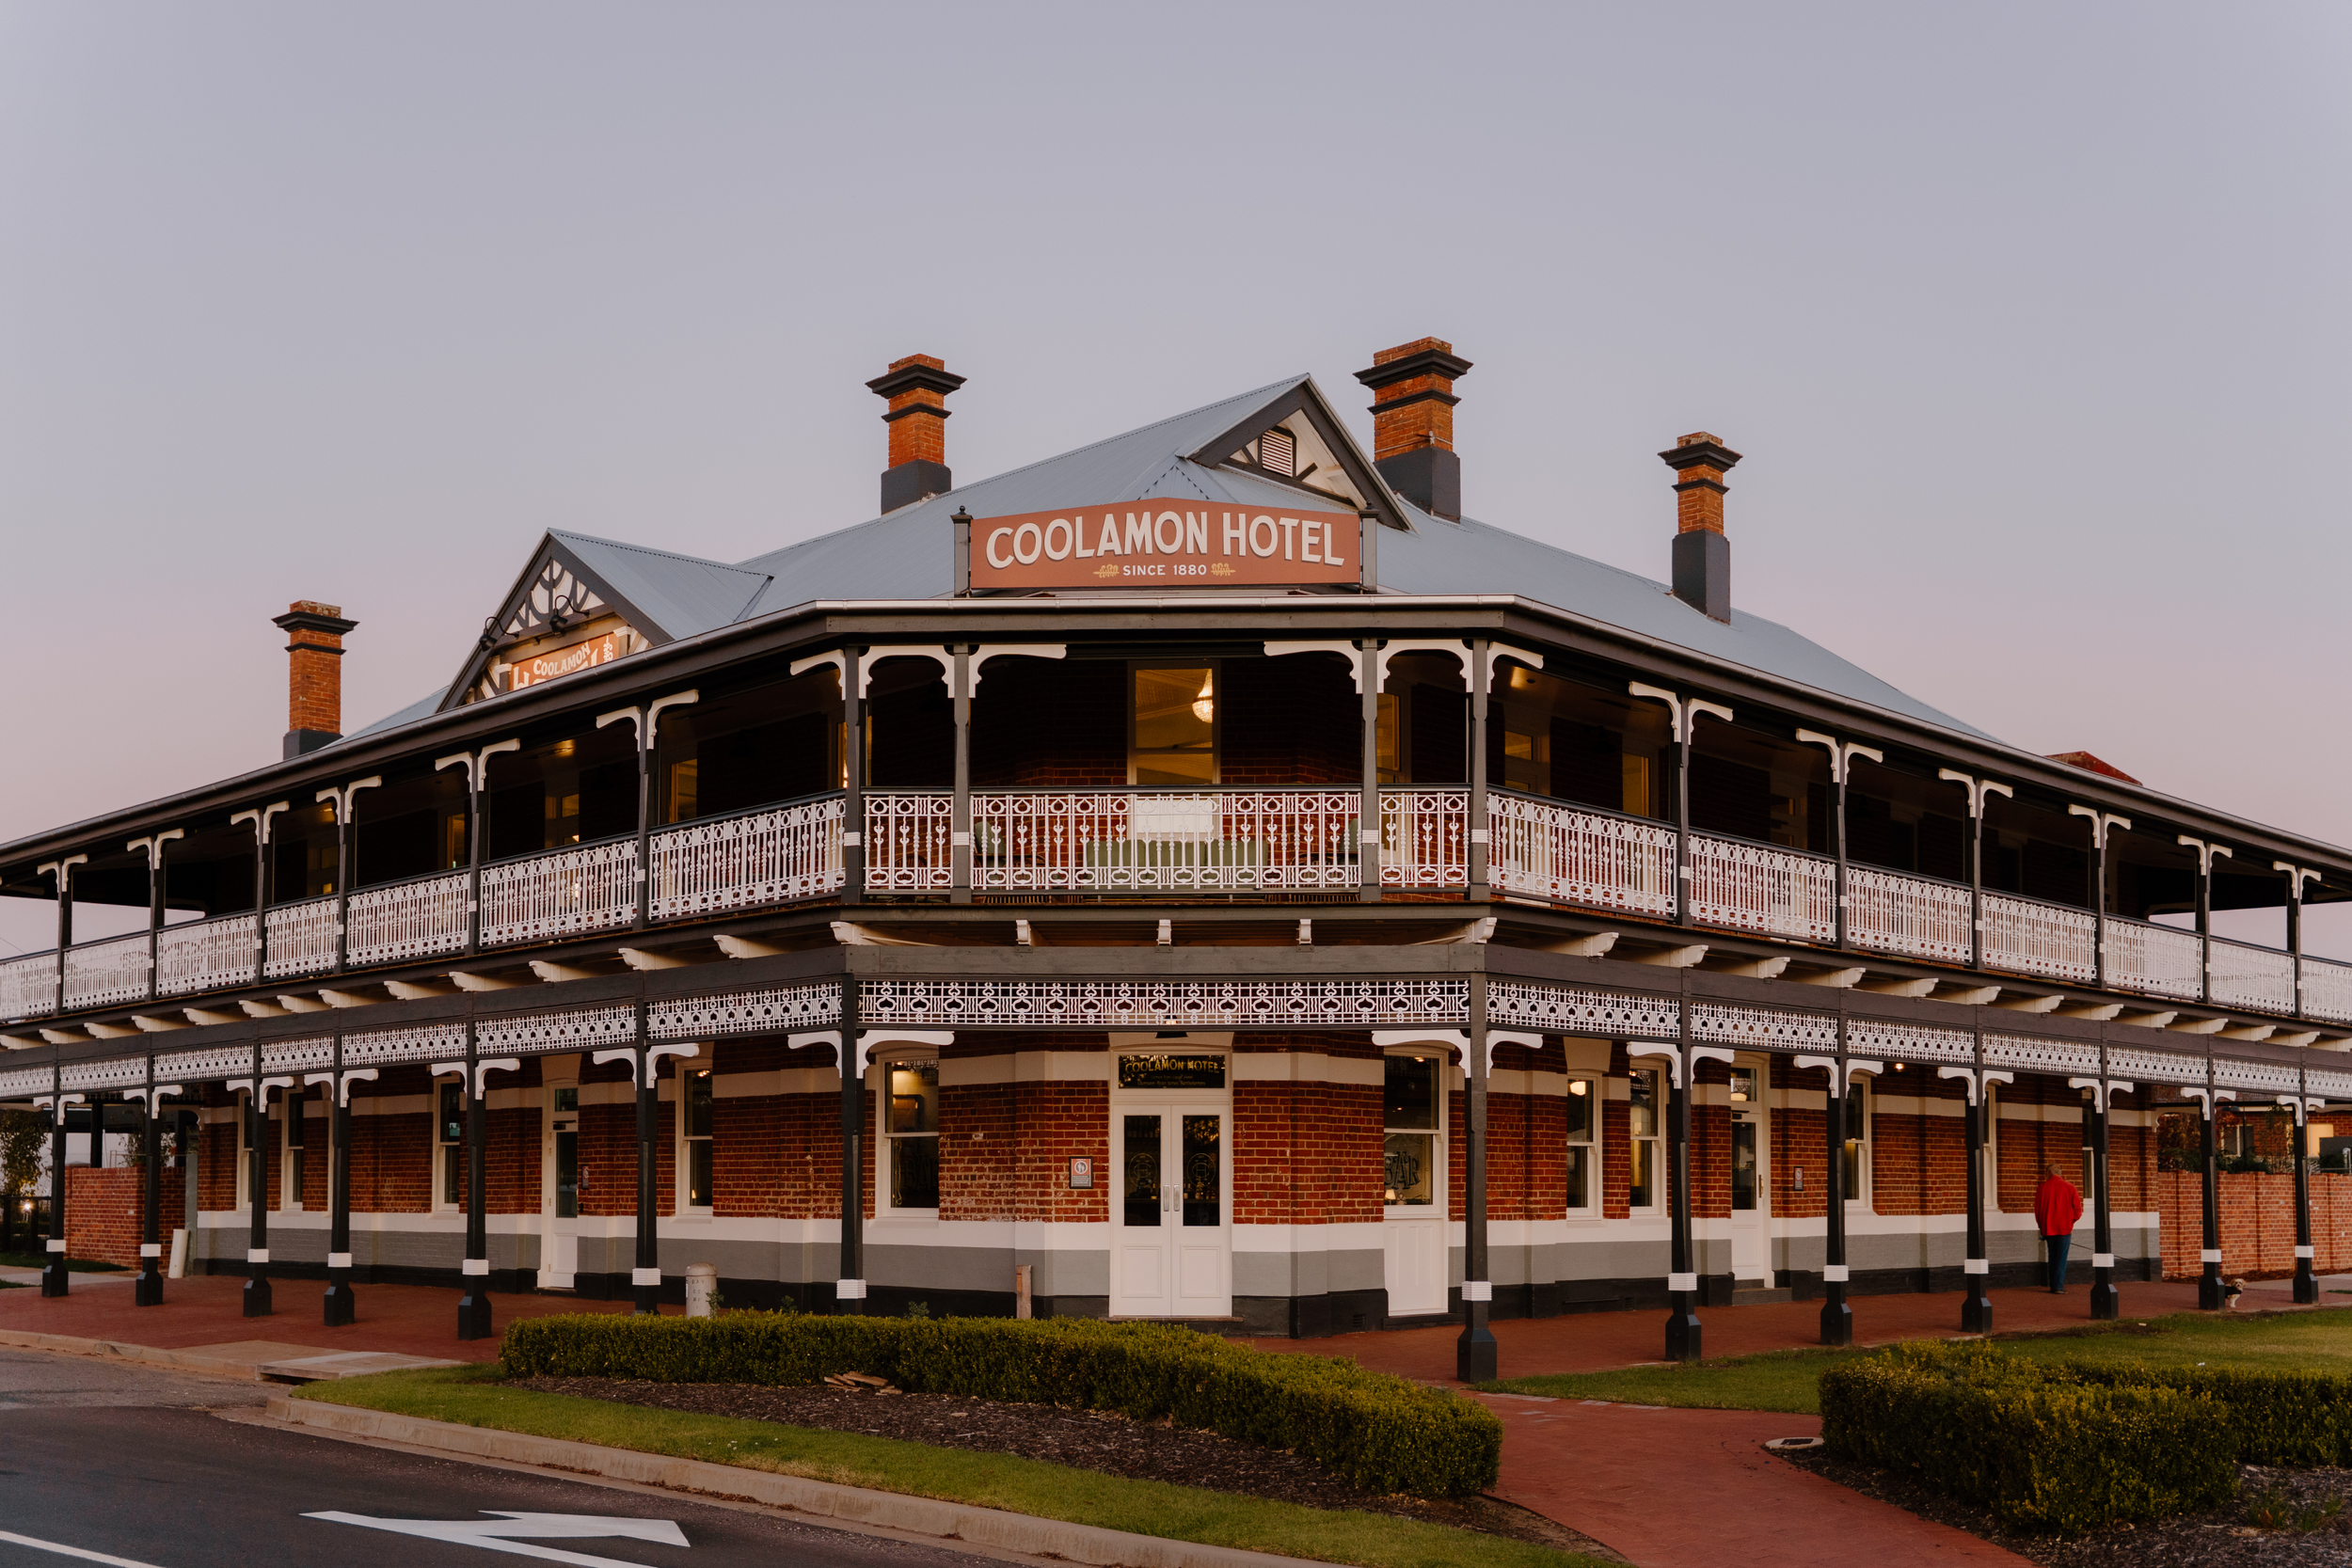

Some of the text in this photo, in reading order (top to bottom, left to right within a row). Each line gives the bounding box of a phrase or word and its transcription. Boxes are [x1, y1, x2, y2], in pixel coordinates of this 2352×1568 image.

[986, 511, 1344, 568] COOLAMON HOTEL
[1122, 564, 1207, 576] SINCE 1880
[532, 641, 591, 676] COOLAMON
[1125, 1059, 1220, 1074] COOLAMON HOTEL
[1384, 1151, 1421, 1190] BAR
